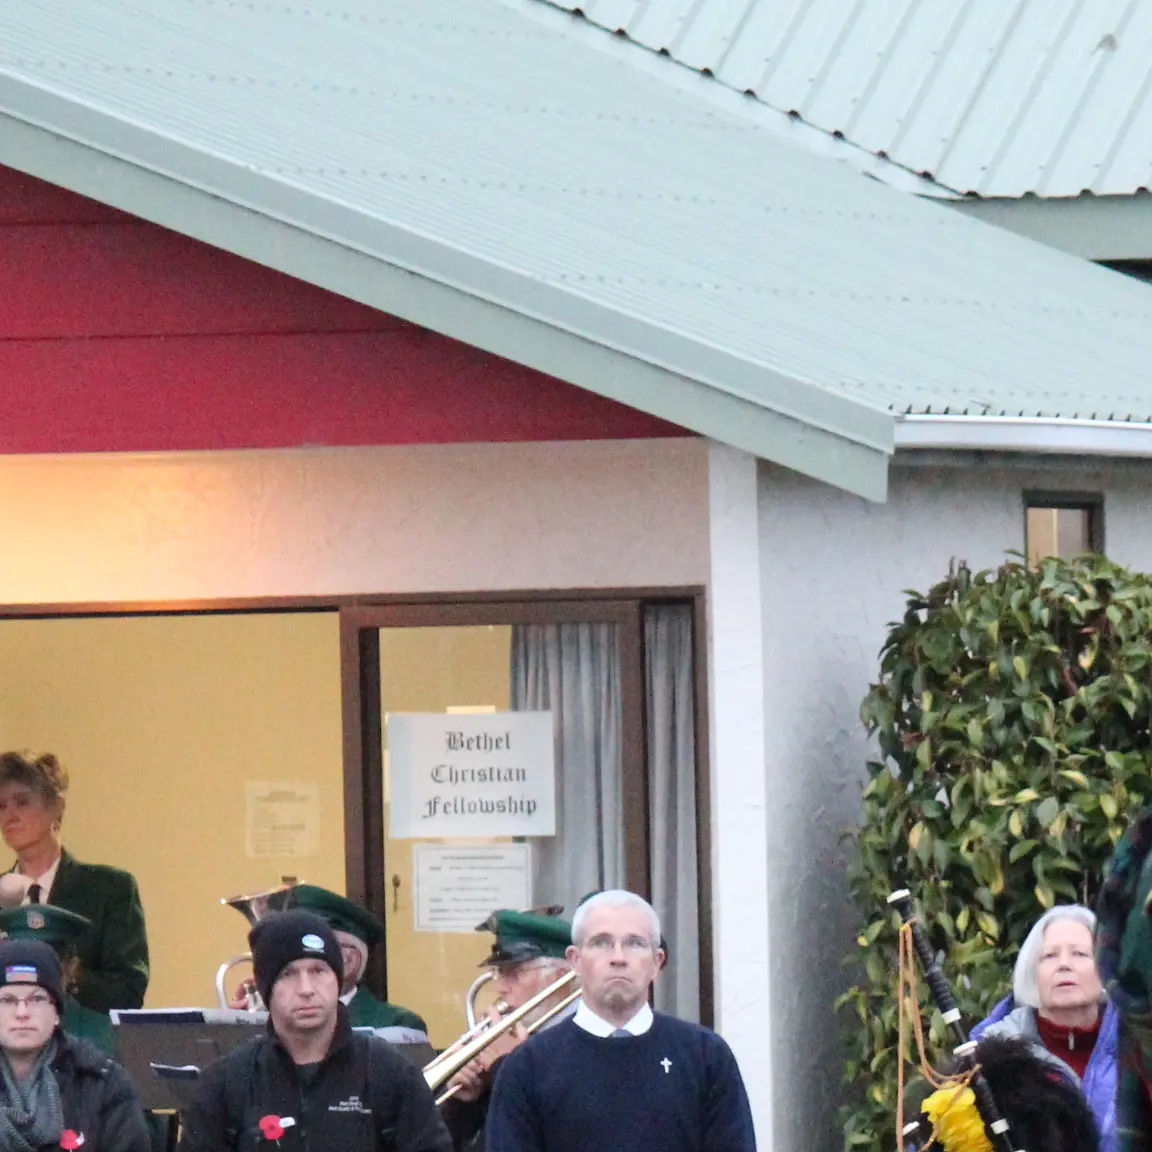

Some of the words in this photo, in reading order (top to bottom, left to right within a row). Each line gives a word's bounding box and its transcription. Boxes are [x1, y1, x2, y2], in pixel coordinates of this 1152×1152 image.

[445, 731, 512, 753] Bethel
[430, 764, 528, 786] Christian
[422, 794, 538, 819] Fellowship
